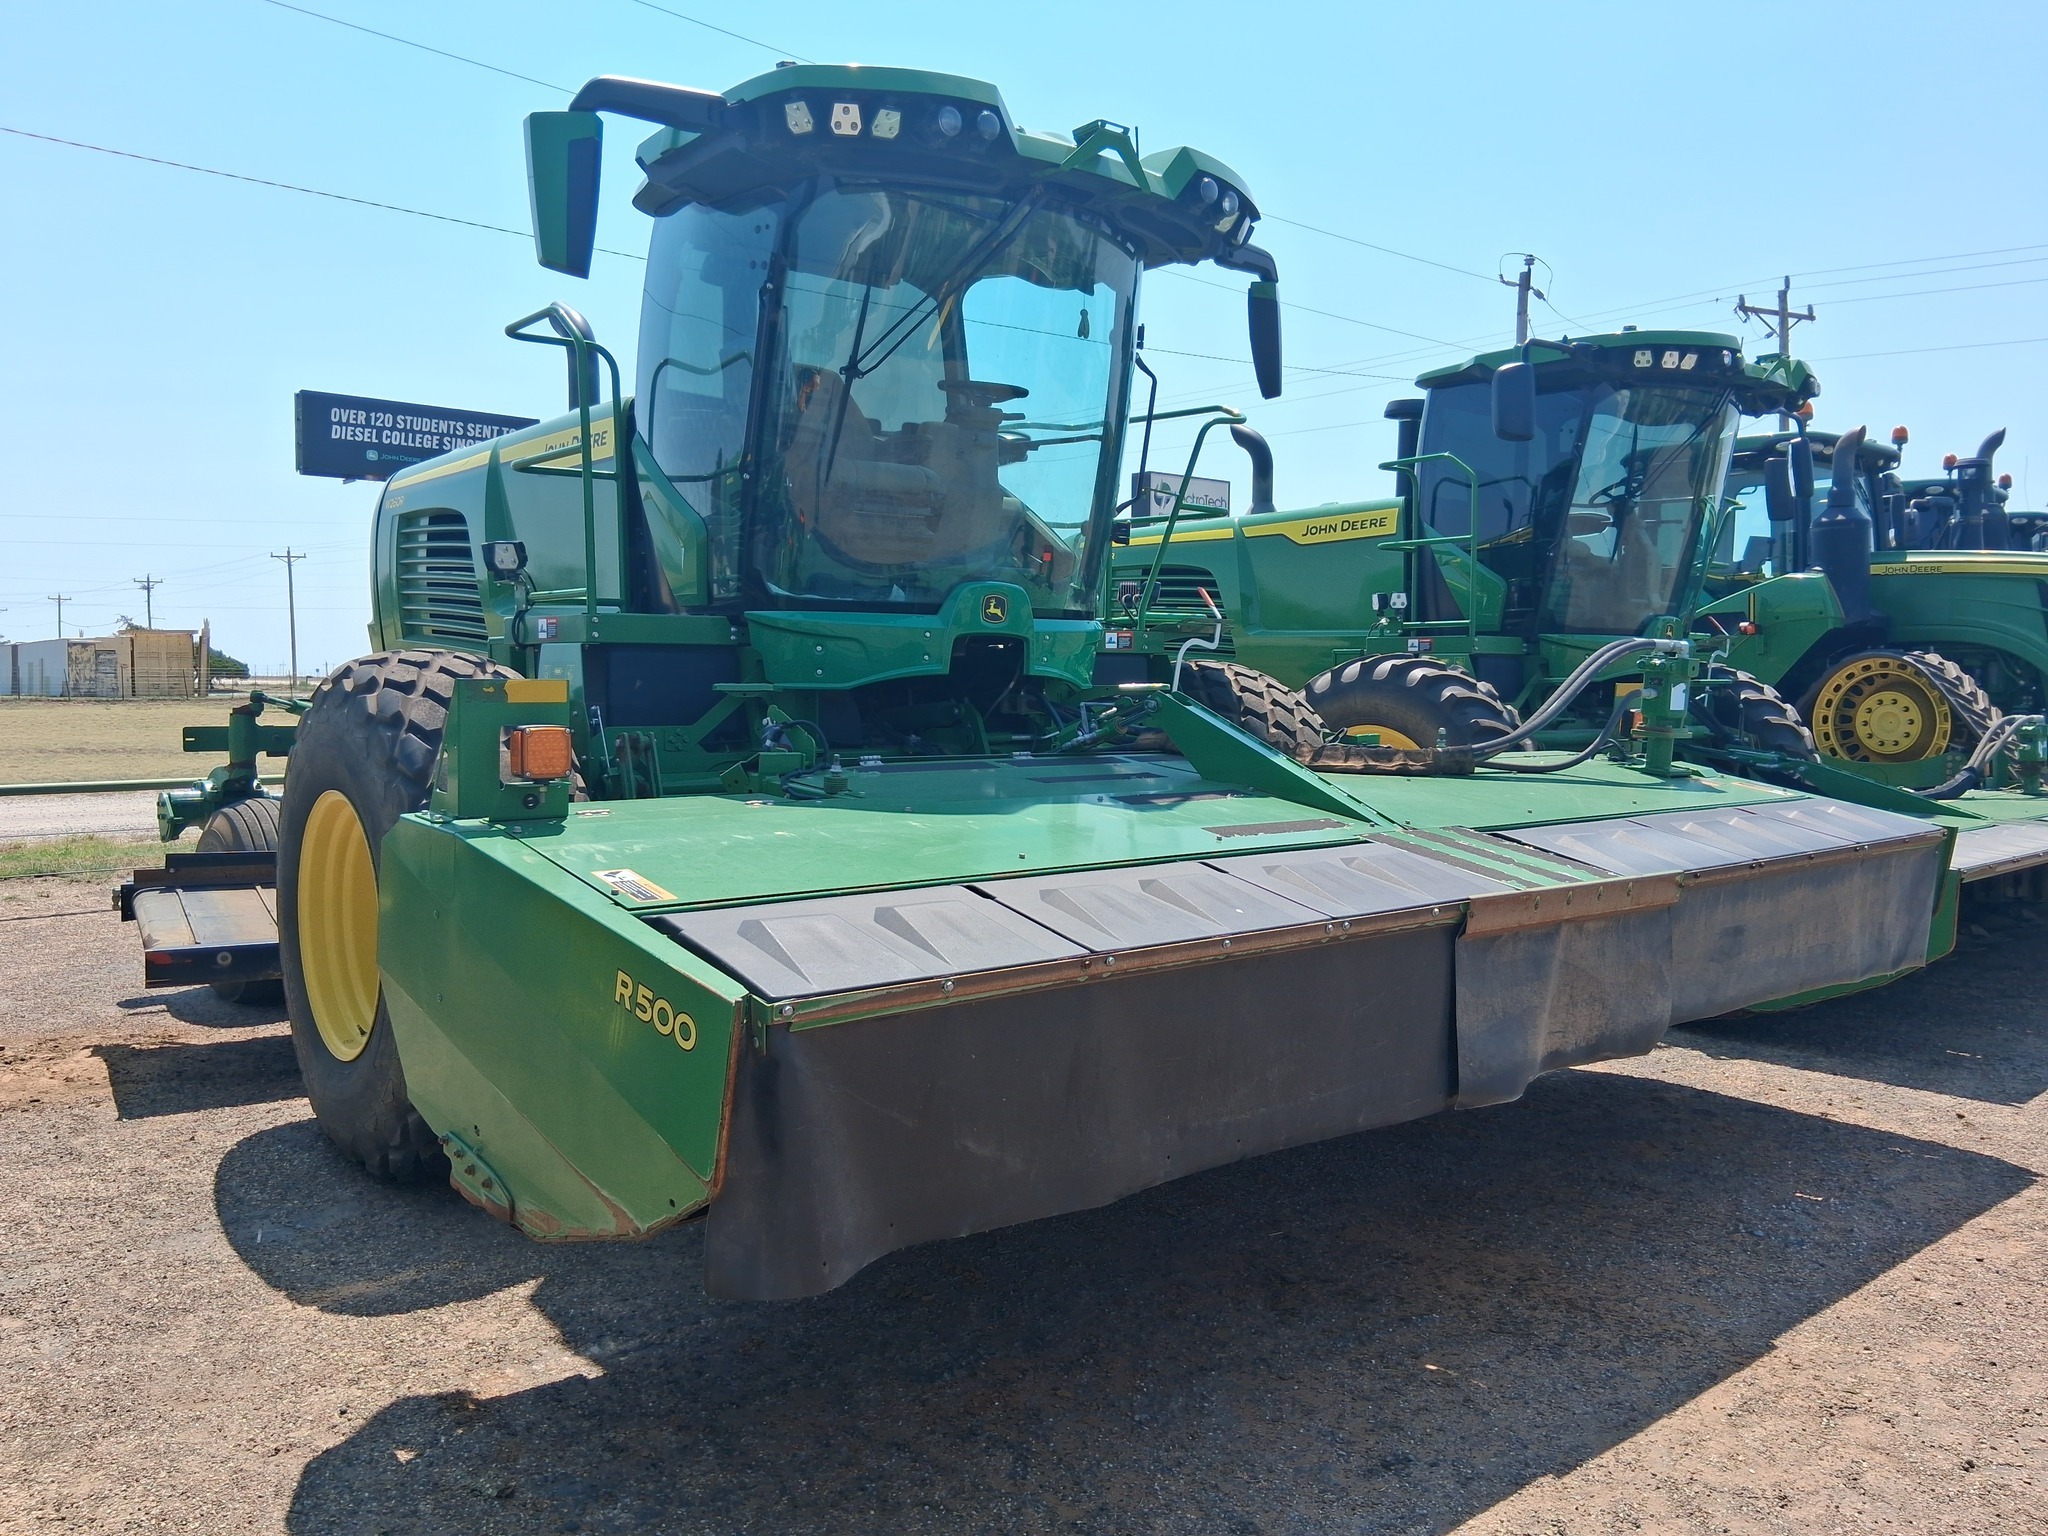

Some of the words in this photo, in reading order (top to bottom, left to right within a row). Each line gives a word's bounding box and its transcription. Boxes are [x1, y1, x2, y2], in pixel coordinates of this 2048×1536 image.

[331, 407, 366, 425] OVER
[369, 412, 393, 428] 120
[396, 414, 464, 436] STUDENTS
[466, 423, 499, 439] SENT
[331, 425, 379, 443] DIESEL
[382, 430, 440, 449] COLLEGE
[571, 430, 608, 449] DRE
[380, 453, 399, 461] JOHN
[400, 455, 422, 463] DEERE
[1301, 524, 1338, 537] JOHN
[1340, 517, 1388, 532] DEERE
[1881, 566, 1909, 574] JOHN
[1909, 564, 1943, 573] DEERE
[614, 968, 698, 1051] R500
